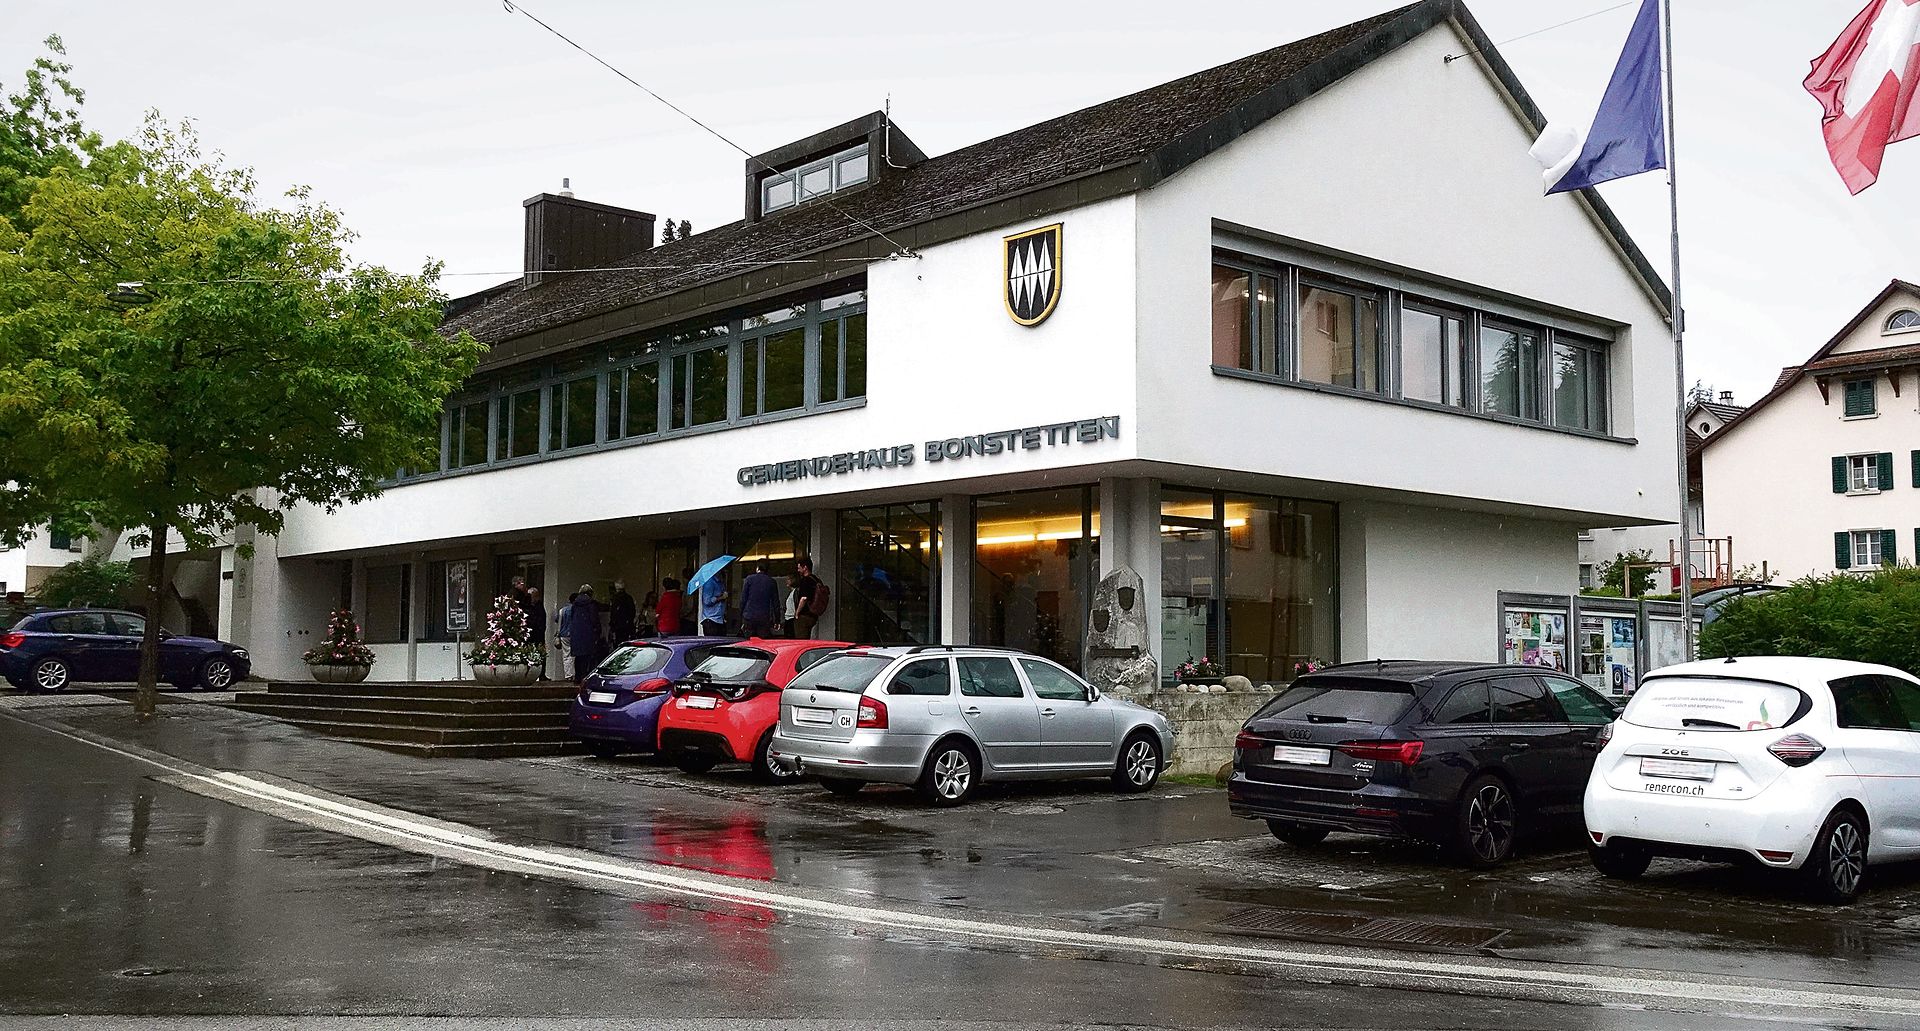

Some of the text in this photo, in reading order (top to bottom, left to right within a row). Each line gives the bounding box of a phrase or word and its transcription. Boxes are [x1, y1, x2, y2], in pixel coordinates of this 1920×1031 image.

[737, 415, 1120, 486] GEMEINDEHAUS BONSTETTEN
[841, 717, 851, 726] CH
[1662, 748, 1689, 756] ZOE
[1645, 783, 1704, 796] renercon.ch
